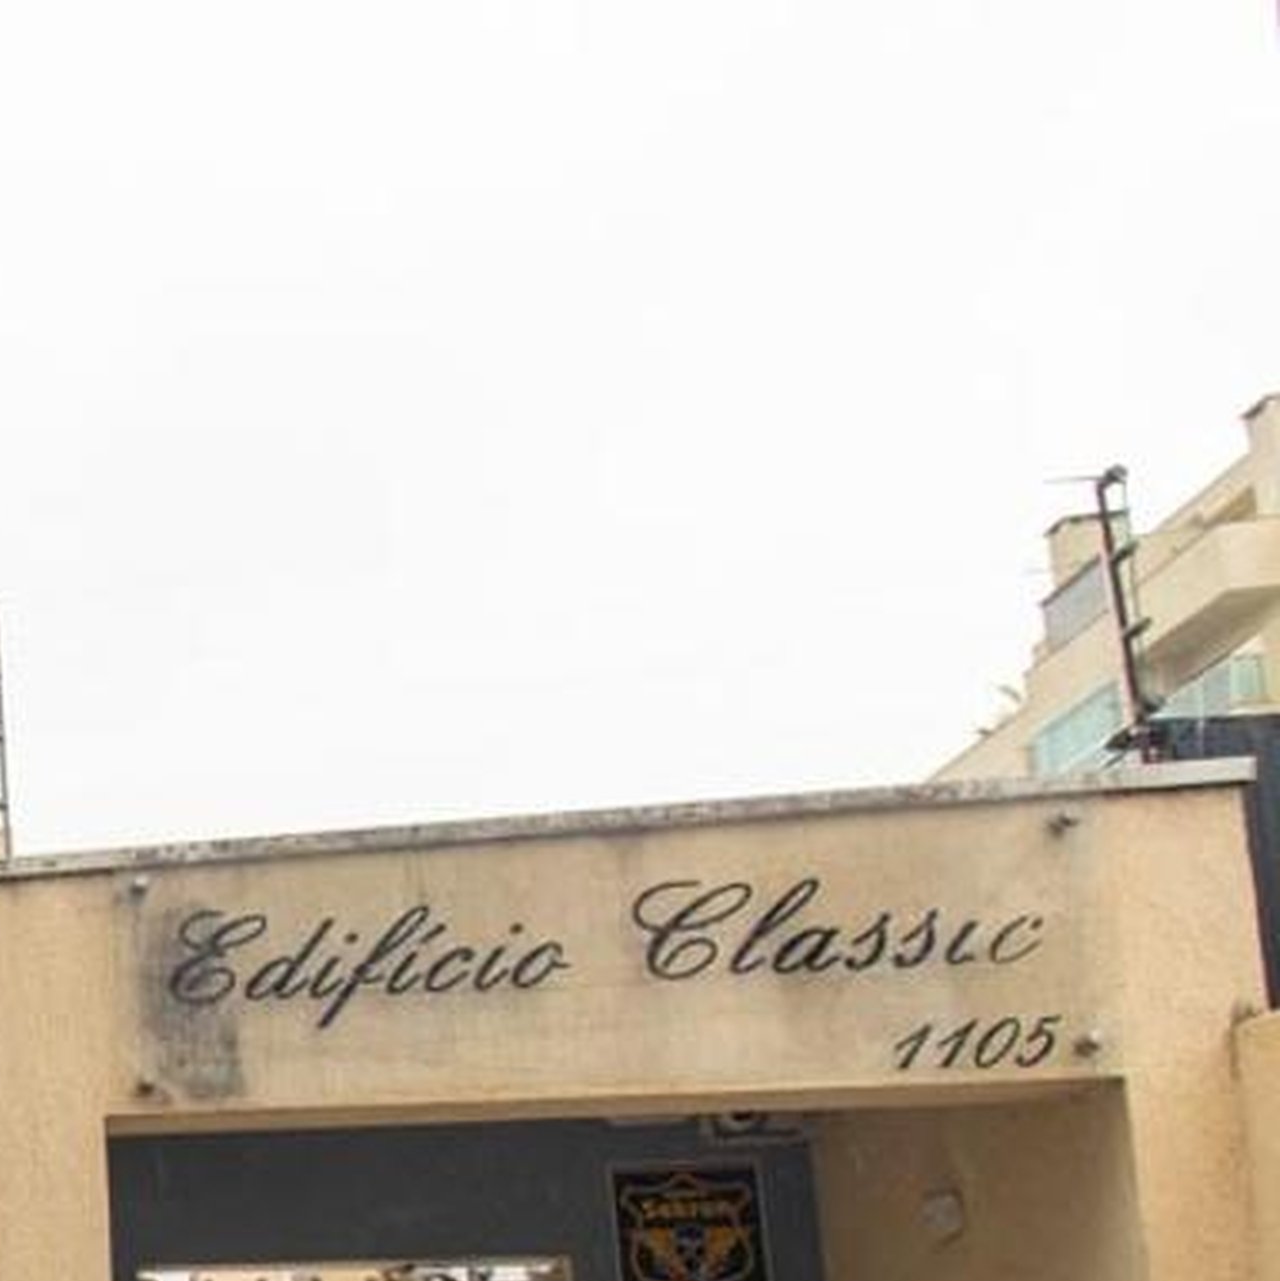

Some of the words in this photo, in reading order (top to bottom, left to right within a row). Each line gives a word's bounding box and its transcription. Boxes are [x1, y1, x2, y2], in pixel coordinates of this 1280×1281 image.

[168, 905, 572, 1029] Edifício
[632, 877, 1045, 981] Classic
[893, 1014, 1062, 1070] 1105
